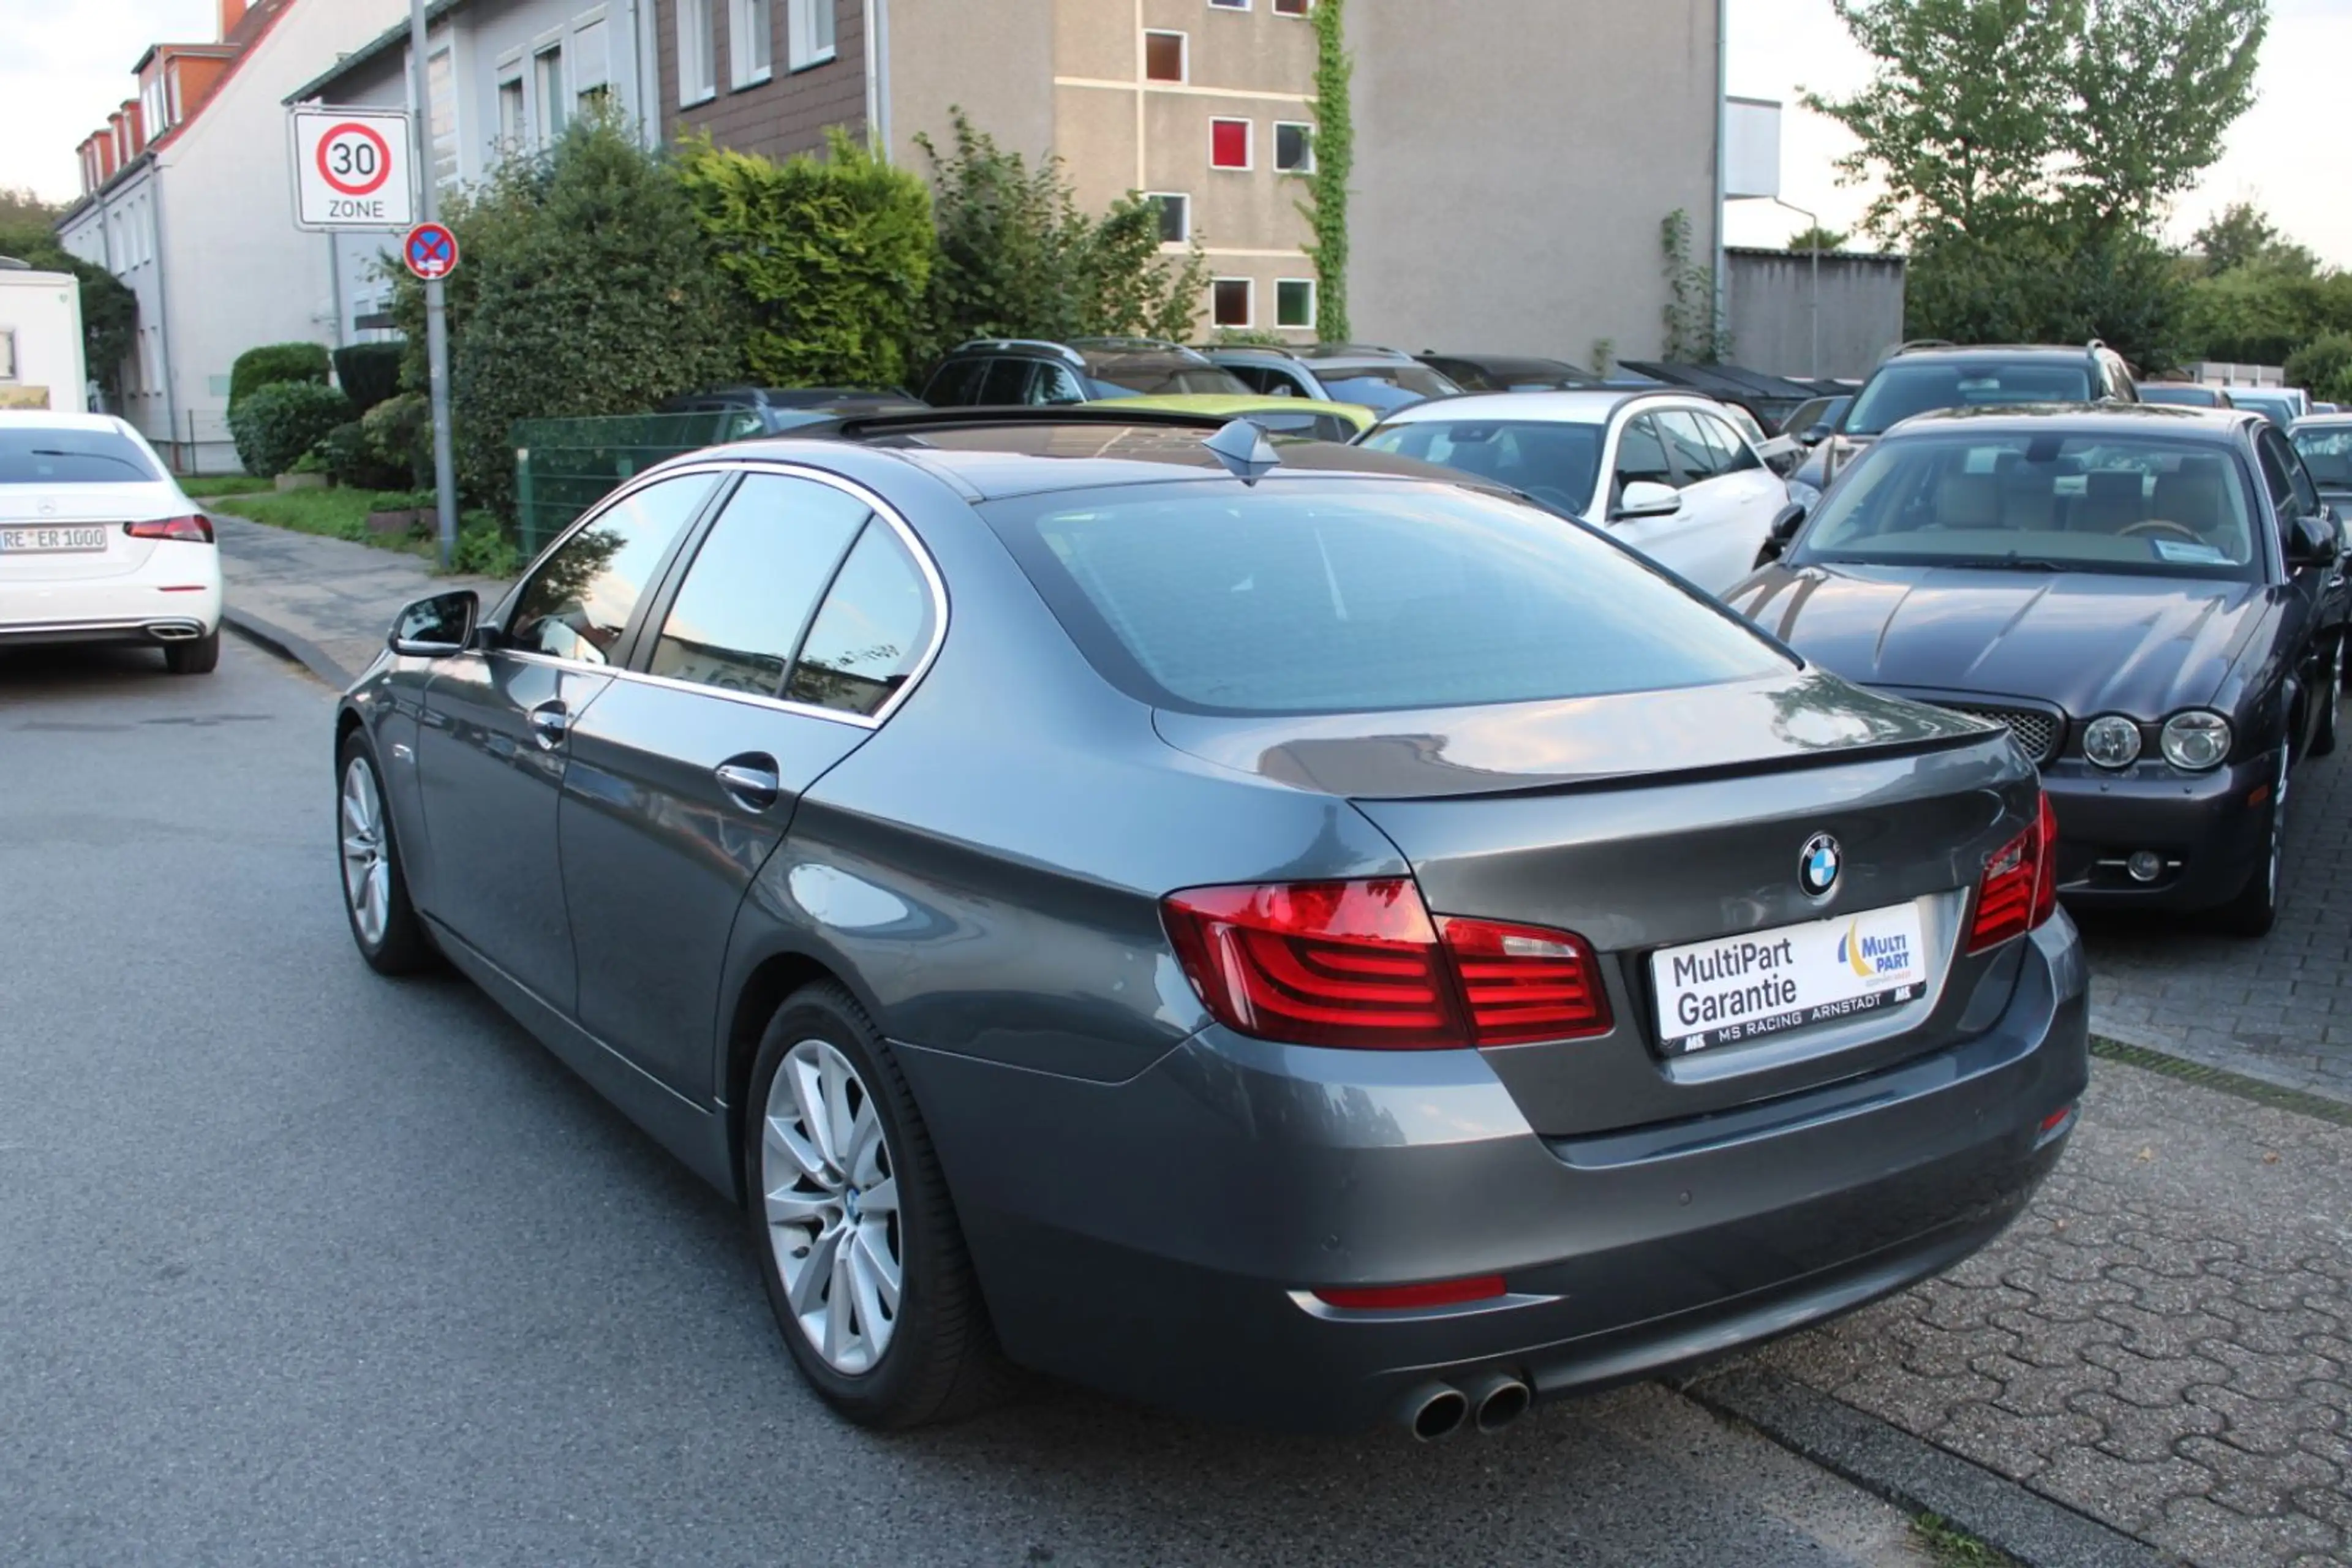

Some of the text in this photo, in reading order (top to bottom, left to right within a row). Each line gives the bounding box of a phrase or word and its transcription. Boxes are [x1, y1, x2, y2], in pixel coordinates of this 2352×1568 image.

[333, 143, 375, 175] 30
[329, 200, 385, 218] ZONE
[4, 529, 104, 548] RE ER 1000
[1673, 938, 1793, 987] MultiPart
[1876, 952, 1909, 973] PART
[1678, 973, 1797, 1026] Garantie
[1719, 1027, 1741, 1042] MS
[1746, 1011, 1803, 1035] RACING
[1811, 993, 1881, 1020] ARNSTADT
